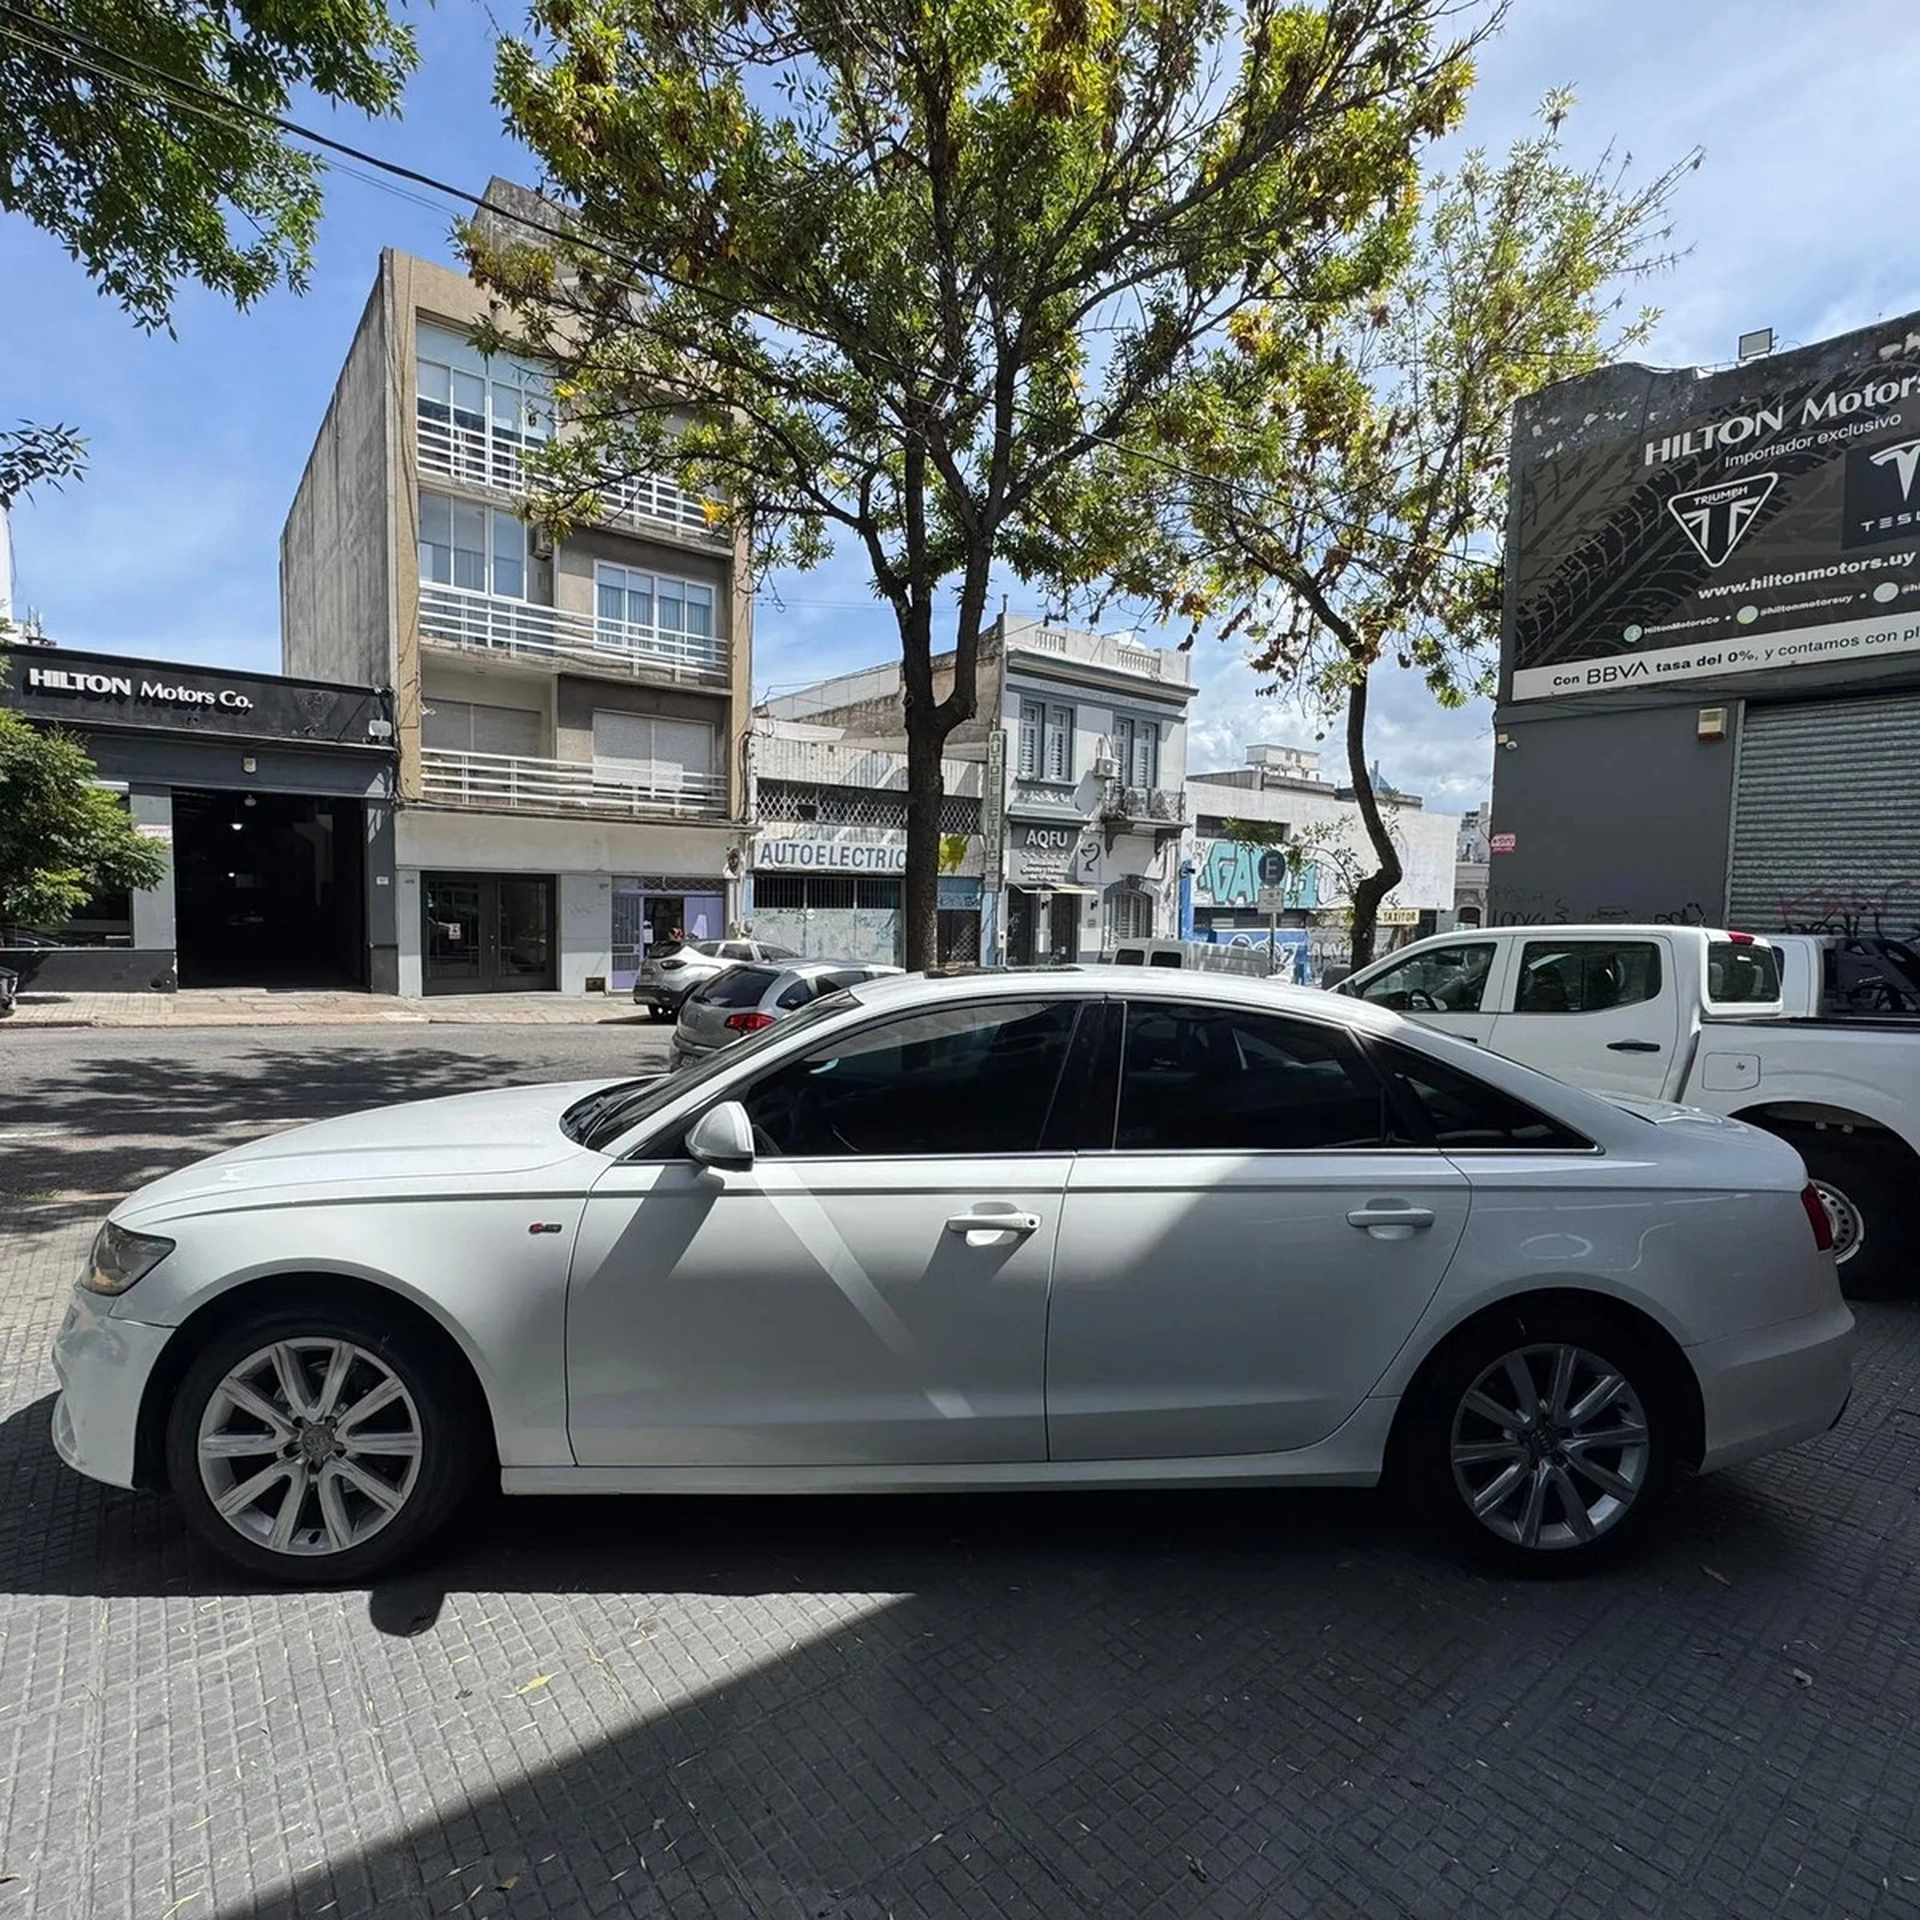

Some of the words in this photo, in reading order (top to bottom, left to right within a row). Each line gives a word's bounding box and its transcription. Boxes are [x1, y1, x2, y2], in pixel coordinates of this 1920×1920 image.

[1644, 406, 1784, 466] HILTON
[1725, 436, 1813, 468] Importador
[1817, 413, 1901, 444] exclusivo
[1694, 486, 1748, 505] TRIUMPH
[1698, 552, 1916, 600] www.hiltonmotors.uy
[1553, 676, 1580, 686] Con
[1587, 661, 1649, 685] BBVA
[1656, 661, 1691, 672] tasa
[1697, 654, 1722, 667] del
[1727, 650, 1758, 664] 0%,
[1764, 649, 1774, 660] y
[1778, 637, 1860, 657] contamos
[1865, 632, 1897, 644] con
[29, 668, 132, 696] HILTON
[140, 681, 216, 705] Motors
[219, 690, 253, 708] Co.
[1026, 829, 1068, 848] AQFU
[1266, 857, 1277, 879] E
